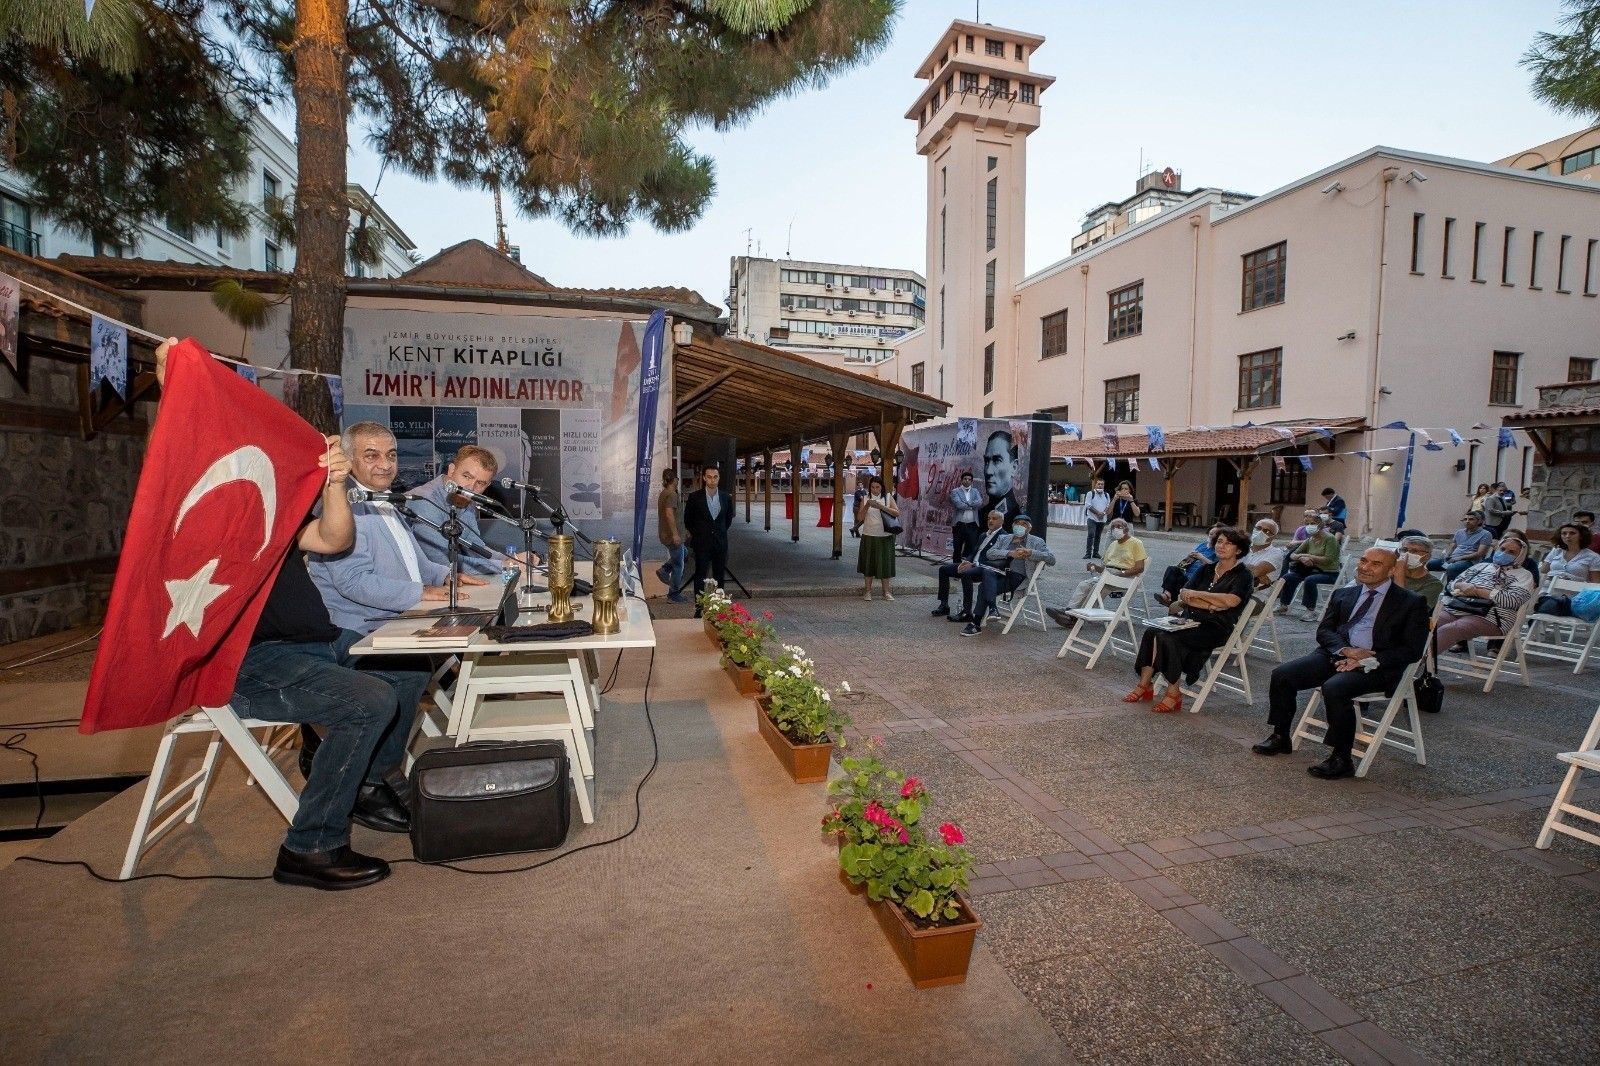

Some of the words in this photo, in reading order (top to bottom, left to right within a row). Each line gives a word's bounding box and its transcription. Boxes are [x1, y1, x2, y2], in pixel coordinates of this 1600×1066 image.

[389, 345, 445, 363] KENT
[454, 344, 562, 367] KİTAPLIĞI
[365, 368, 436, 398] İZMİR'İ
[444, 375, 583, 401] AYDINLATIYOR
